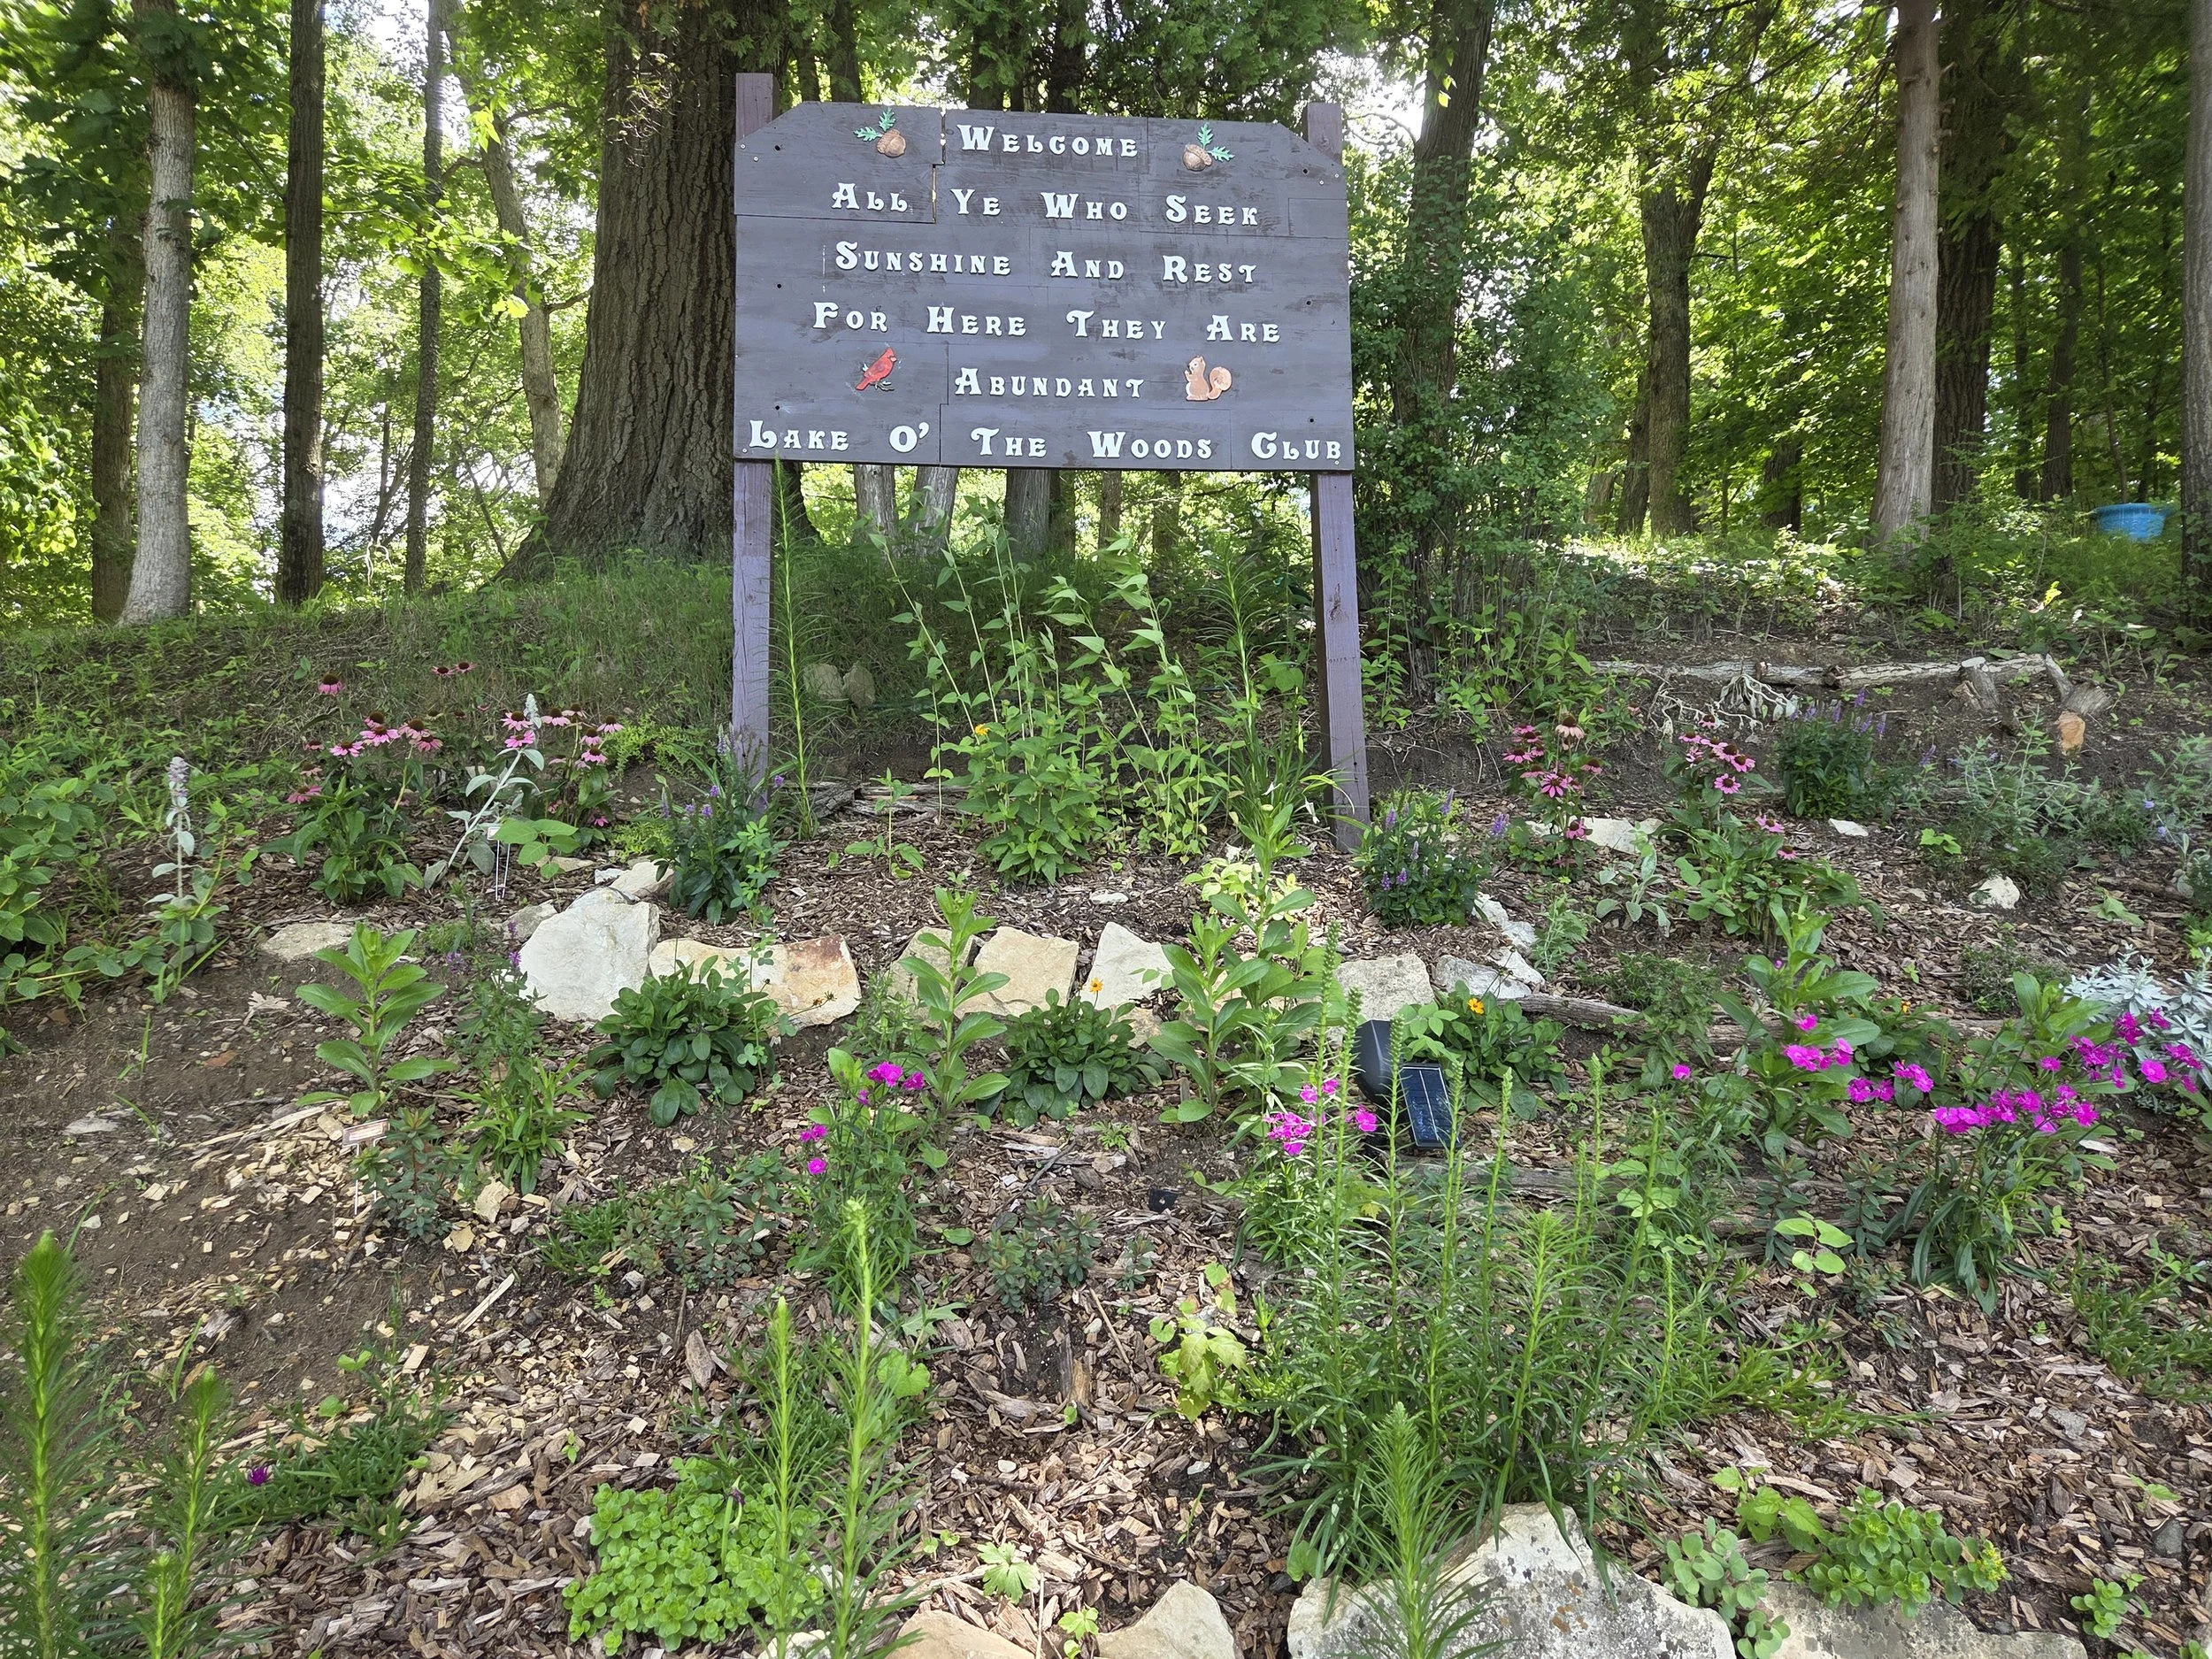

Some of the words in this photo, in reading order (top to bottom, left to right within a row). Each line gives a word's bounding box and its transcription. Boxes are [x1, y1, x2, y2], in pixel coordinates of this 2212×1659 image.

[956, 124, 1138, 157] WELCOME
[831, 181, 908, 212] ALL
[950, 188, 1001, 216] YE
[1041, 191, 1127, 220] WHO
[1165, 194, 1258, 226] SEEK
[835, 241, 1011, 275] SUNSHINE
[1050, 250, 1125, 280] AND
[1162, 255, 1257, 283] REST
[812, 301, 887, 332] FOR
[926, 305, 1026, 336] HERE
[1065, 309, 1166, 340] THEY
[1206, 314, 1280, 342] ARE
[954, 366, 1145, 398] ABUNDANT
[749, 419, 849, 451] LAKE
[970, 426, 1047, 457] THE
[1087, 430, 1212, 459] WOODS
[1250, 431, 1342, 460] CLUB
